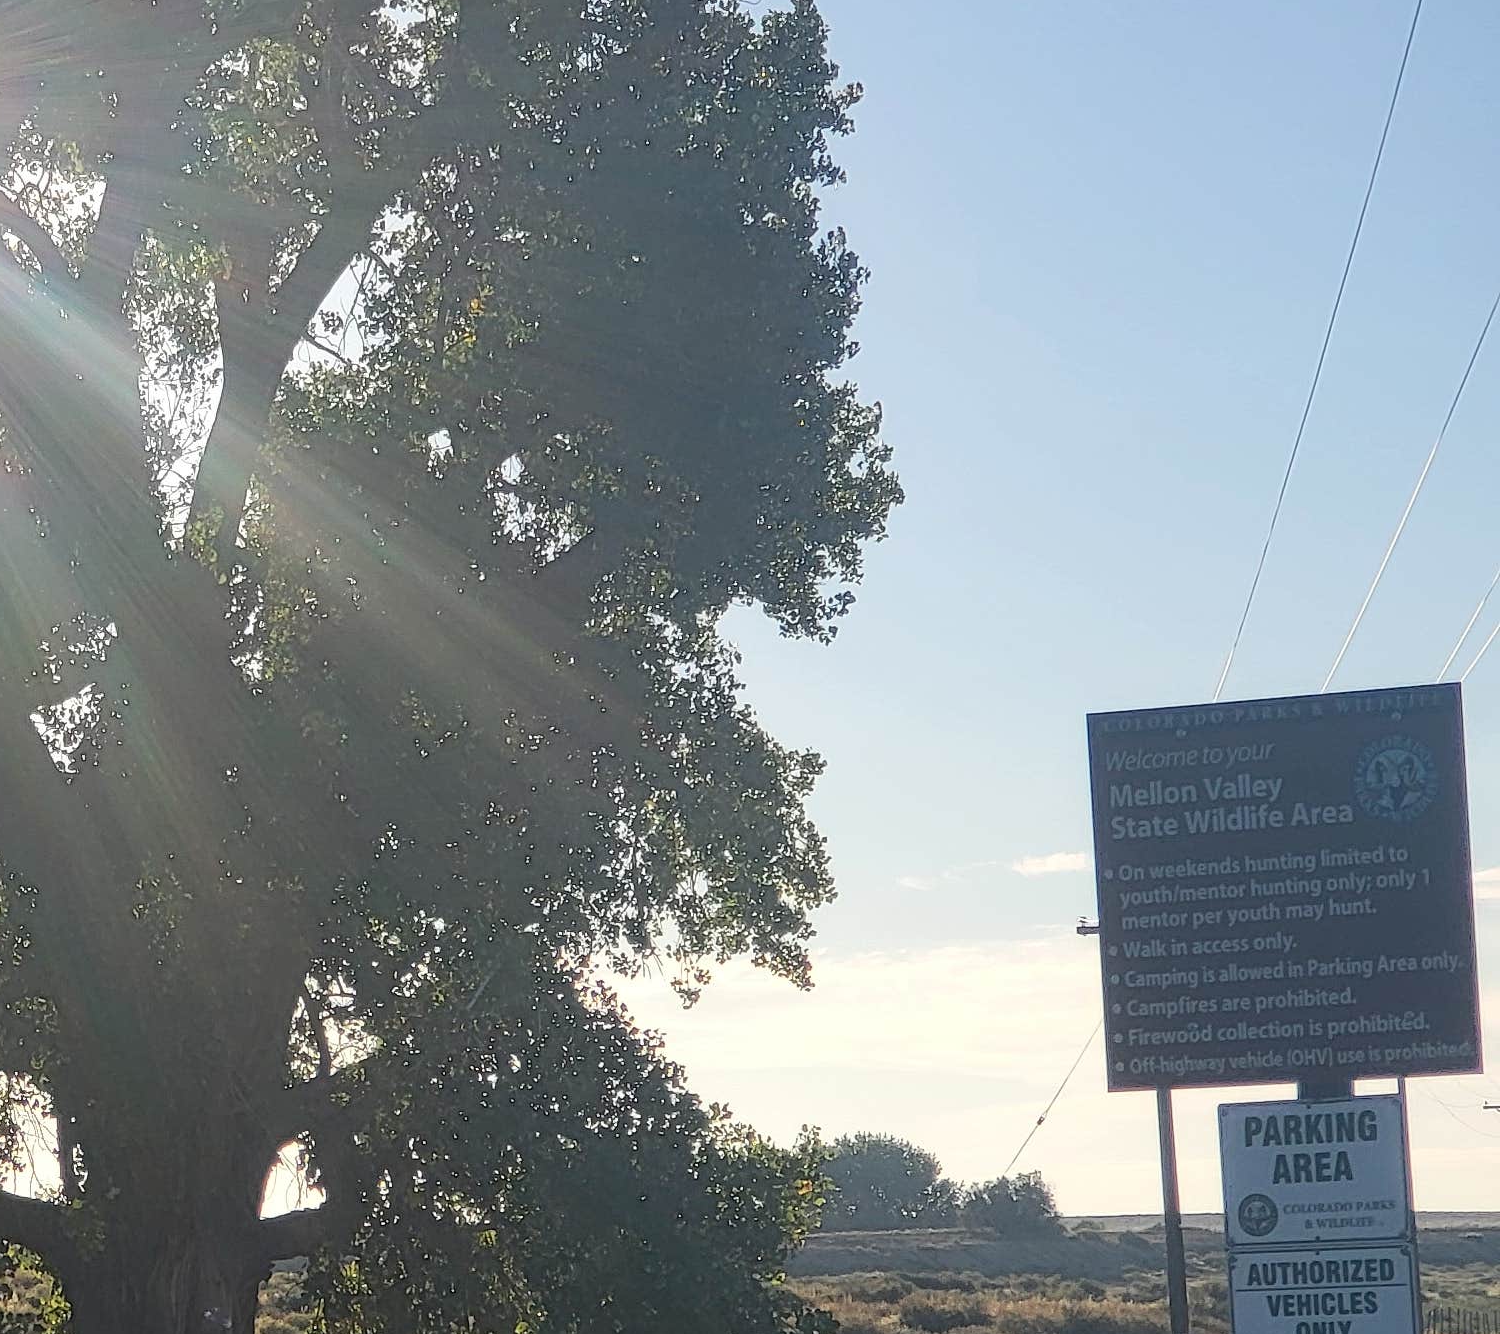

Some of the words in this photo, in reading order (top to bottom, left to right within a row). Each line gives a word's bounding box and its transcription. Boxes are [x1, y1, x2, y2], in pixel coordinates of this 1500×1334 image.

[1106, 747, 1197, 772] Welcome
[1203, 747, 1222, 765] to
[1226, 743, 1276, 769] your
[1110, 780, 1198, 808] Mellon
[1203, 773, 1283, 802] Valley
[1111, 816, 1178, 840] State
[1184, 806, 1284, 835] Wildlife
[1290, 802, 1353, 827] Area
[1119, 865, 1145, 882] On
[1150, 856, 1240, 879] weekends
[1244, 852, 1316, 873] hunting
[1320, 846, 1383, 867] limited
[1388, 847, 1409, 862] to
[1119, 884, 1246, 910] youth/mentor
[1250, 877, 1321, 897] hunting
[1326, 872, 1372, 893] only;
[1376, 870, 1416, 890] only
[1422, 869, 1430, 885] 1
[1122, 913, 1188, 931] mentor
[1192, 911, 1223, 929] per
[1227, 903, 1281, 927] youth
[1285, 903, 1325, 921] may
[1329, 898, 1377, 917] hunt.
[1123, 939, 1167, 958] Walk
[1171, 939, 1188, 956] in
[1192, 938, 1249, 955] access
[1253, 931, 1297, 954] only.
[1124, 968, 1199, 989] Camping
[1203, 967, 1215, 983] is
[1219, 961, 1284, 981] allowed
[1288, 961, 1303, 978] in
[1308, 957, 1373, 978] Parking
[1377, 955, 1417, 972] Area
[1127, 996, 1218, 1018] Campfires
[1222, 997, 1252, 1012] are
[1256, 987, 1357, 1014] prohibited.
[1129, 1024, 1213, 1047] Firewood
[1217, 1020, 1303, 1042] collection
[1309, 1018, 1322, 1036] is
[1327, 1012, 1430, 1040] prohibited.
[1130, 1055, 1227, 1076] Off-highway
[1229, 1049, 1284, 1070] vehicle
[1337, 1049, 1365, 1065] use
[1369, 1044, 1382, 1062] is
[1244, 1110, 1379, 1148] PARKING
[1272, 1151, 1354, 1185] AREA
[1283, 1202, 1353, 1215] COLORADO
[1356, 1199, 1396, 1212] PARKS
[1305, 1218, 1314, 1229] &
[1316, 1216, 1375, 1229] WILDLIFE
[1246, 1258, 1395, 1287] AUTHORIZED
[1267, 1291, 1378, 1318] VEHICLES
